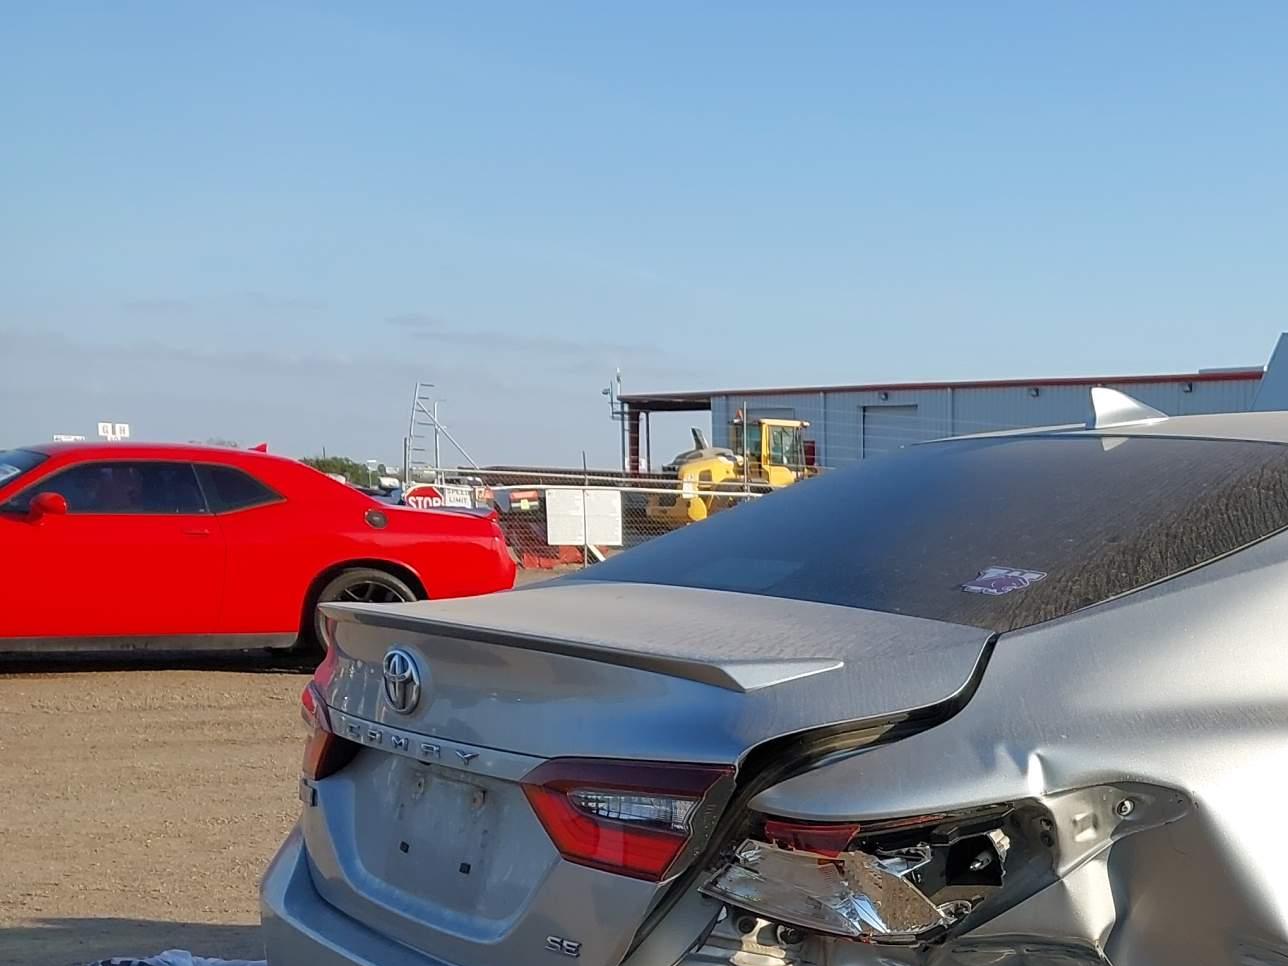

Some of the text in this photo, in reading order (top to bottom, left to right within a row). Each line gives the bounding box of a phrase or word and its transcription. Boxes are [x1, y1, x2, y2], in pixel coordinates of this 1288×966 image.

[408, 496, 441, 509] STOP
[348, 724, 480, 766] CAMRY
[545, 935, 581, 958] SE
